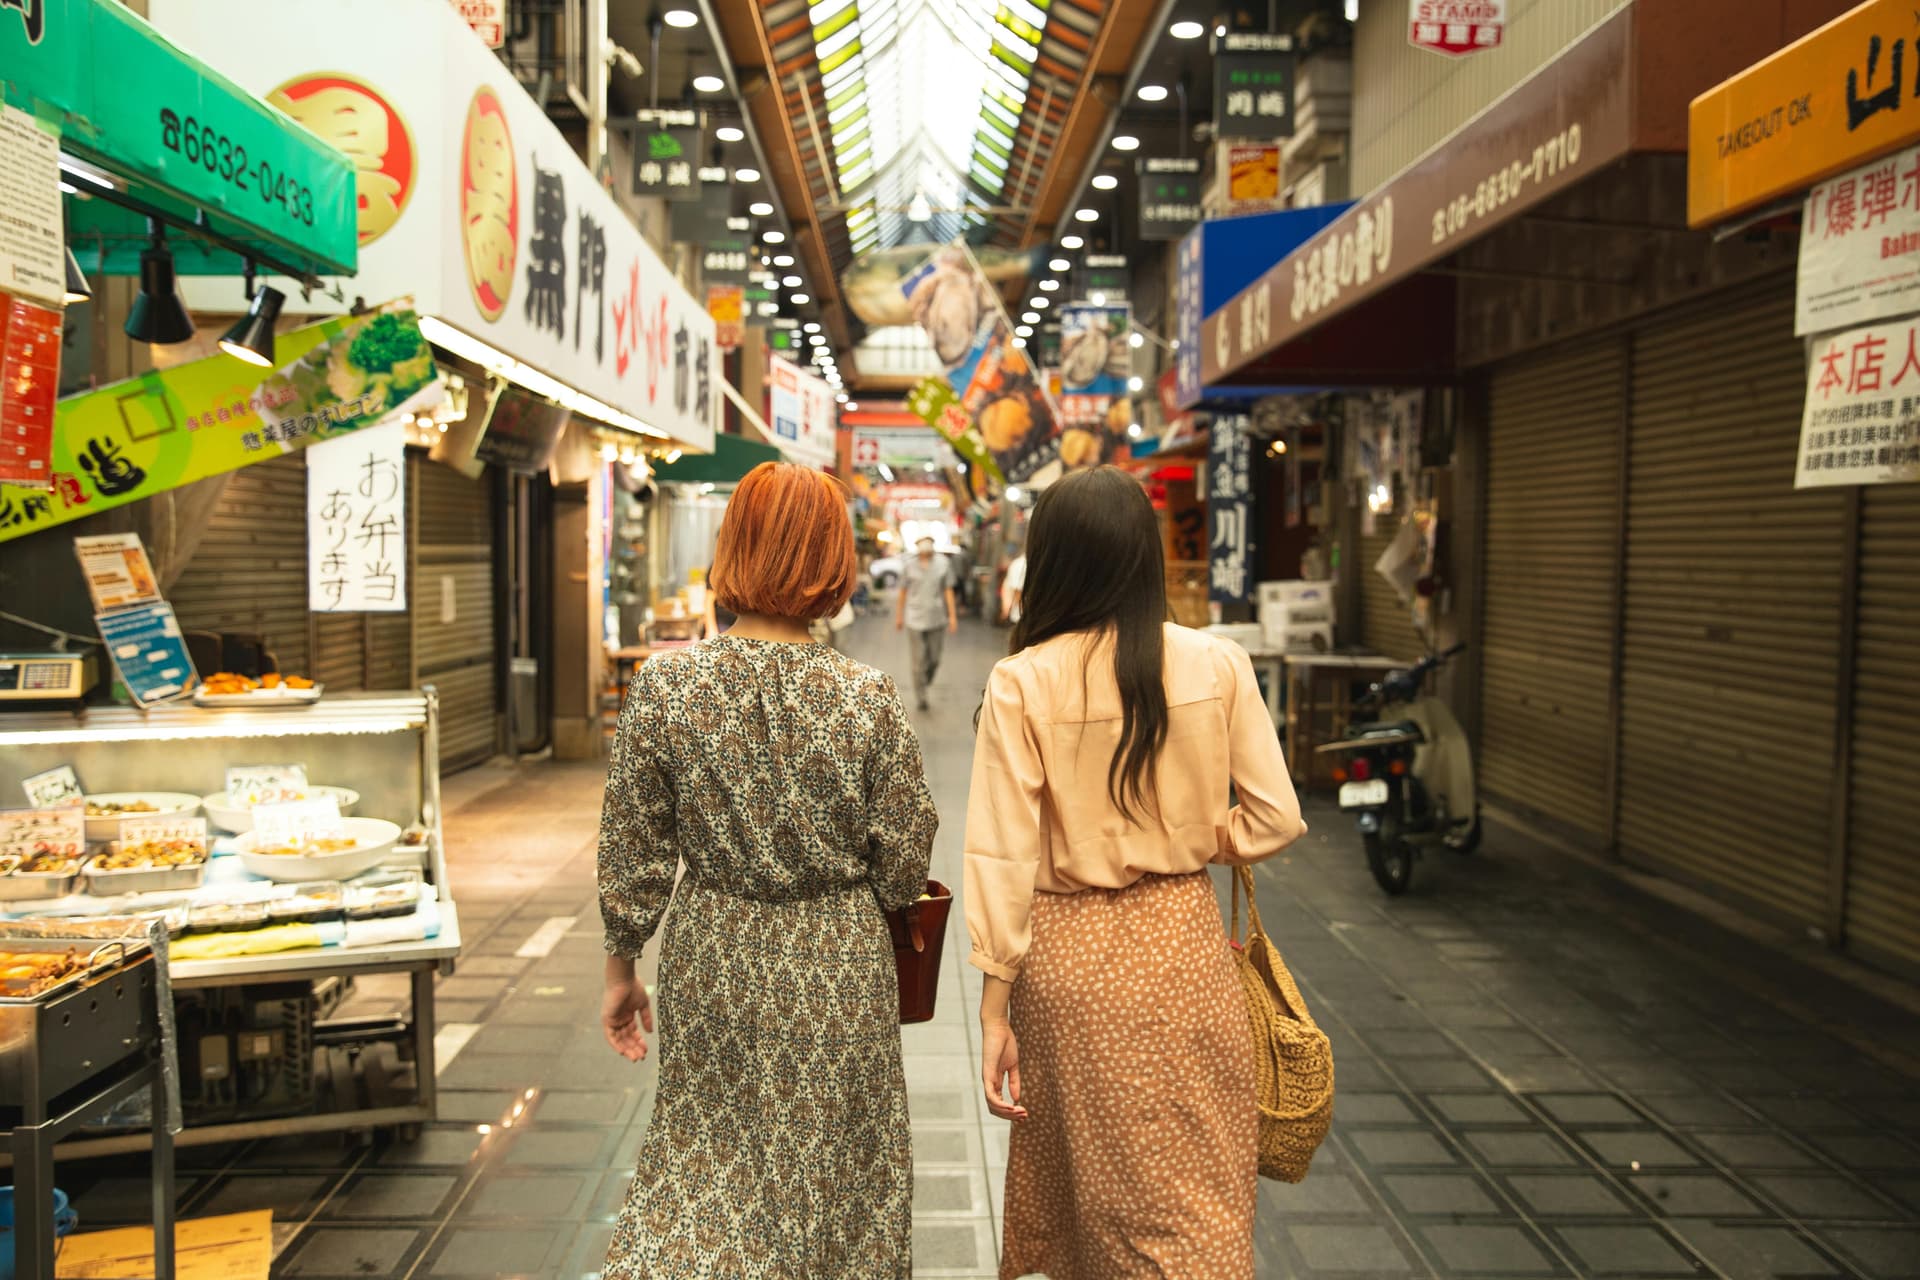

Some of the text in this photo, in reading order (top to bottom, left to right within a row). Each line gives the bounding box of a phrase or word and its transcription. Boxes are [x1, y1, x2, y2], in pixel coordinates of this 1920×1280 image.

[1716, 93, 1812, 159] TAKEOUT OK
[1846, 35, 1920, 132] 山
[318, 488, 353, 611] あります
[353, 451, 401, 602] お弁当
